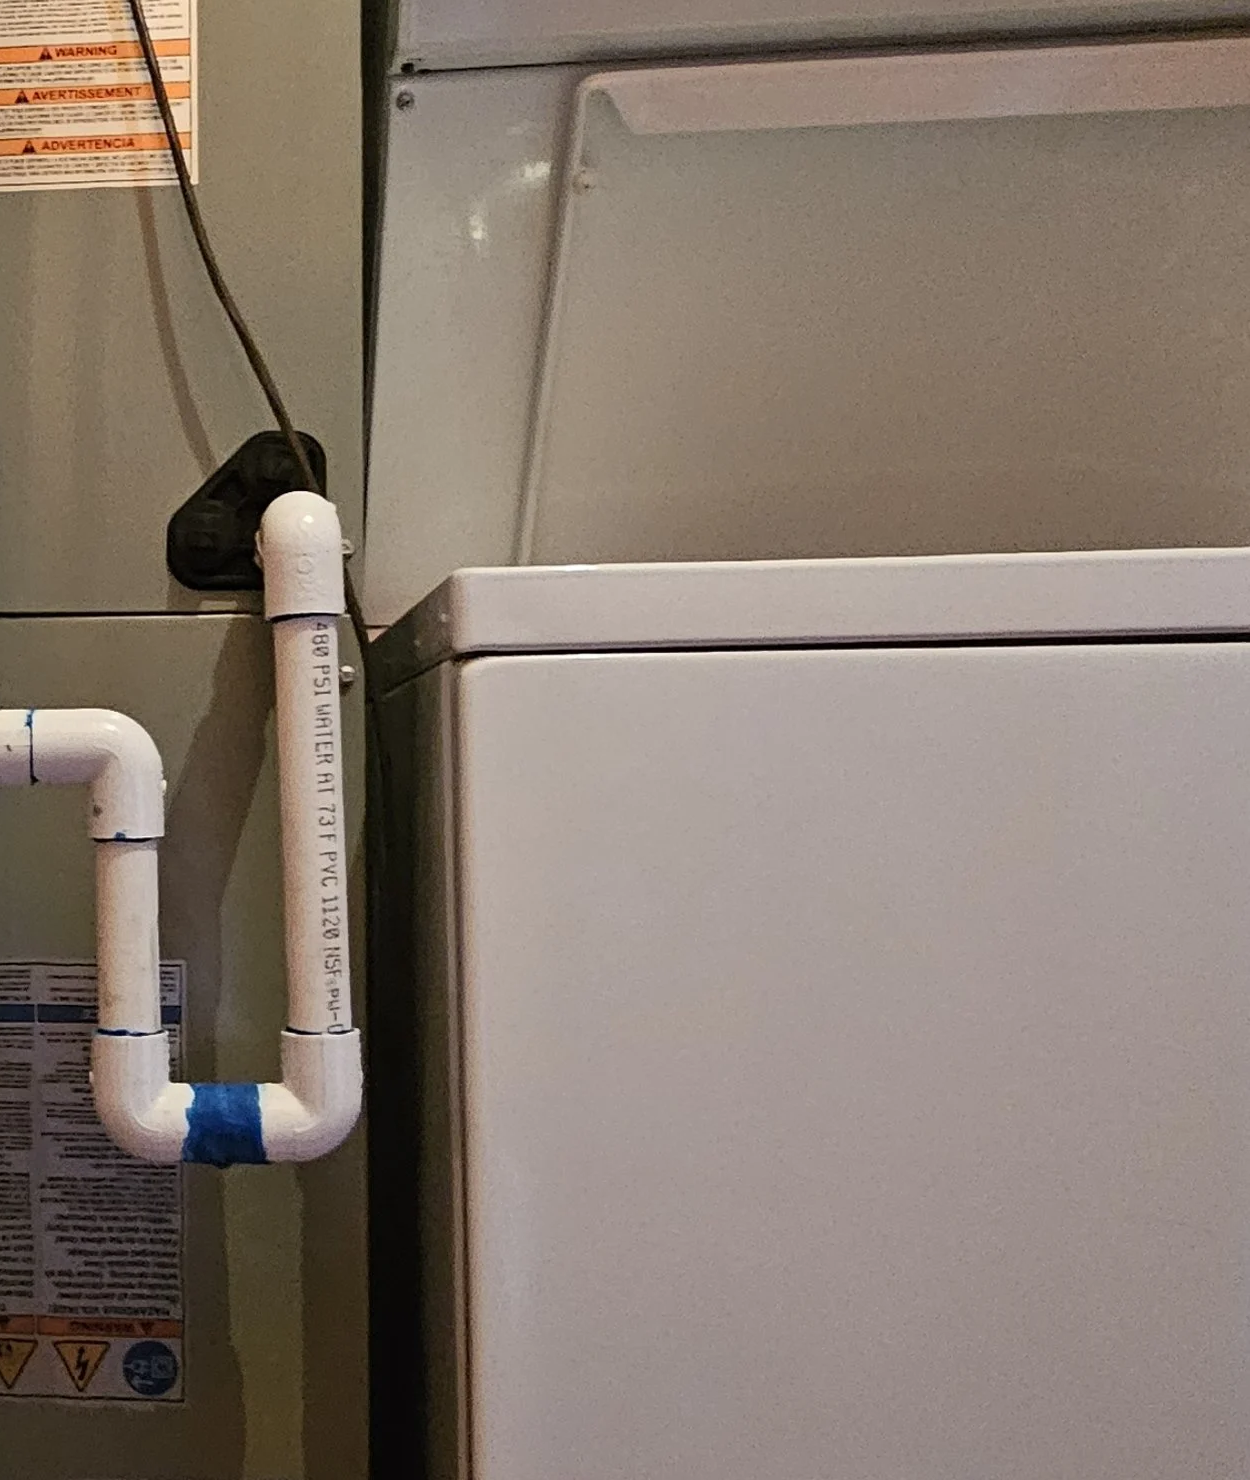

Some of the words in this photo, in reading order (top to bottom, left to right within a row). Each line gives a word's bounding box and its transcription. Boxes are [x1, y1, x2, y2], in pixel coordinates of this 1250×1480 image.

[54, 46, 118, 58] WARNING
[32, 86, 141, 101] AVERTISSEMENT
[41, 138, 135, 152] ADVERTENCIA
[313, 665, 331, 697] PSI
[315, 704, 334, 766] WATER
[317, 773, 335, 795] AT
[319, 851, 338, 888] PVC
[322, 896, 340, 940] 1120
